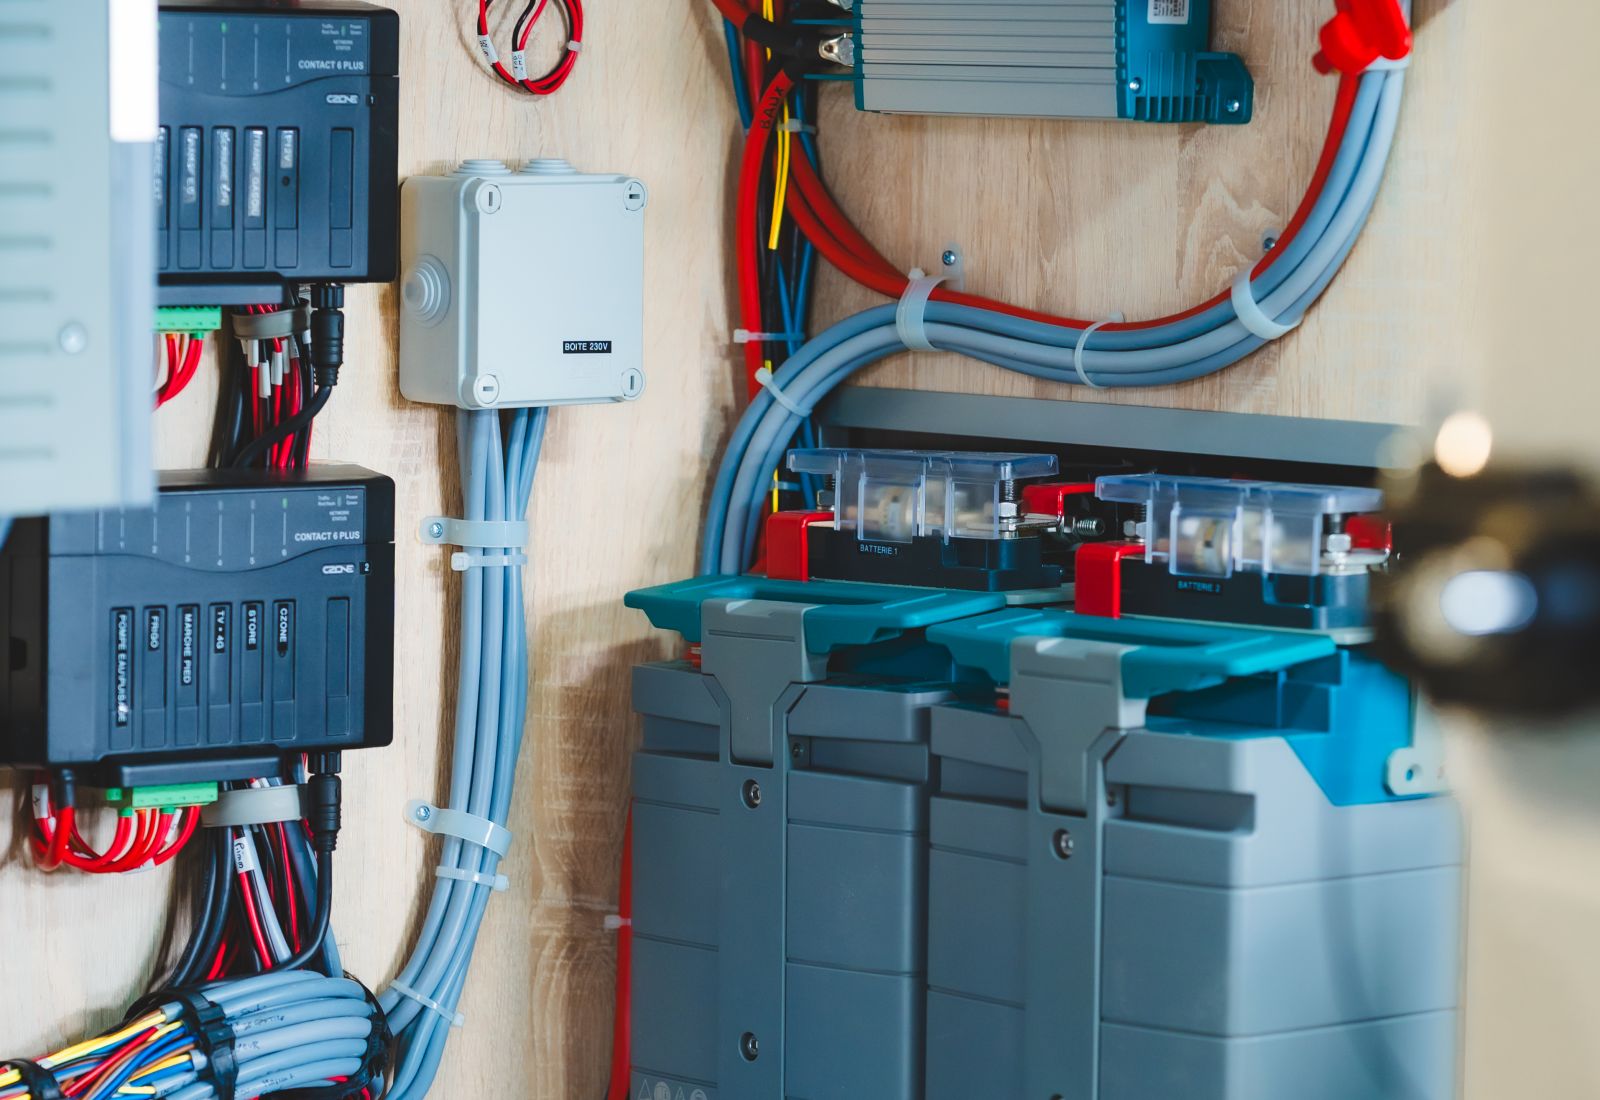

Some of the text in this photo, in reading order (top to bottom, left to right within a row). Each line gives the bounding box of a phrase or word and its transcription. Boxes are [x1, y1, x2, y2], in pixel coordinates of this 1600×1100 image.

[298, 60, 364, 70] CONTACT 6 PLUS
[326, 94, 359, 105] CZONE
[564, 342, 608, 351] BOITE 230V
[294, 531, 360, 542] CONTACT 6 PLUS
[281, 548, 287, 557] 6
[860, 544, 898, 556] BATTERIE 1
[217, 558, 223, 567] 4
[249, 556, 255, 565] 5
[322, 564, 355, 574] CZONE
[364, 562, 370, 572] 2
[1177, 580, 1213, 592] BATTERIE
[215, 610, 225, 650] TV 4G
[248, 609, 257, 645] STORE
[279, 607, 288, 643] CZONE
[117, 614, 127, 650] POMPE
[149, 615, 160, 649] FRIGO
[182, 613, 192, 684] MARCHE PIED
